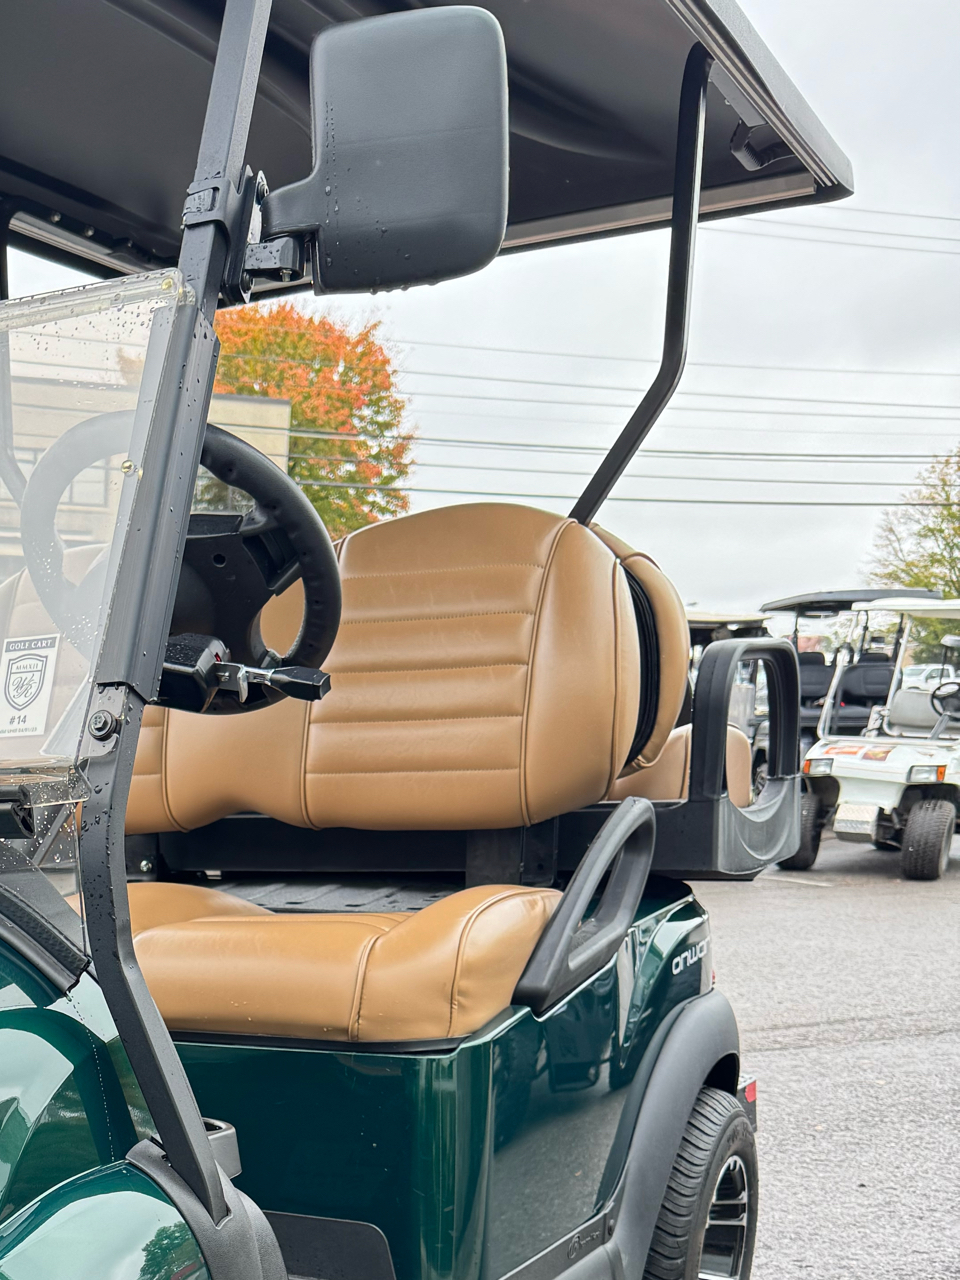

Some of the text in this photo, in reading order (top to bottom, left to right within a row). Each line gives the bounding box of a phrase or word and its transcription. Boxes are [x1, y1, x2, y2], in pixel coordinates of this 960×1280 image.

[9, 640, 52, 650] GOLF CART
[9, 715, 27, 725] #14
